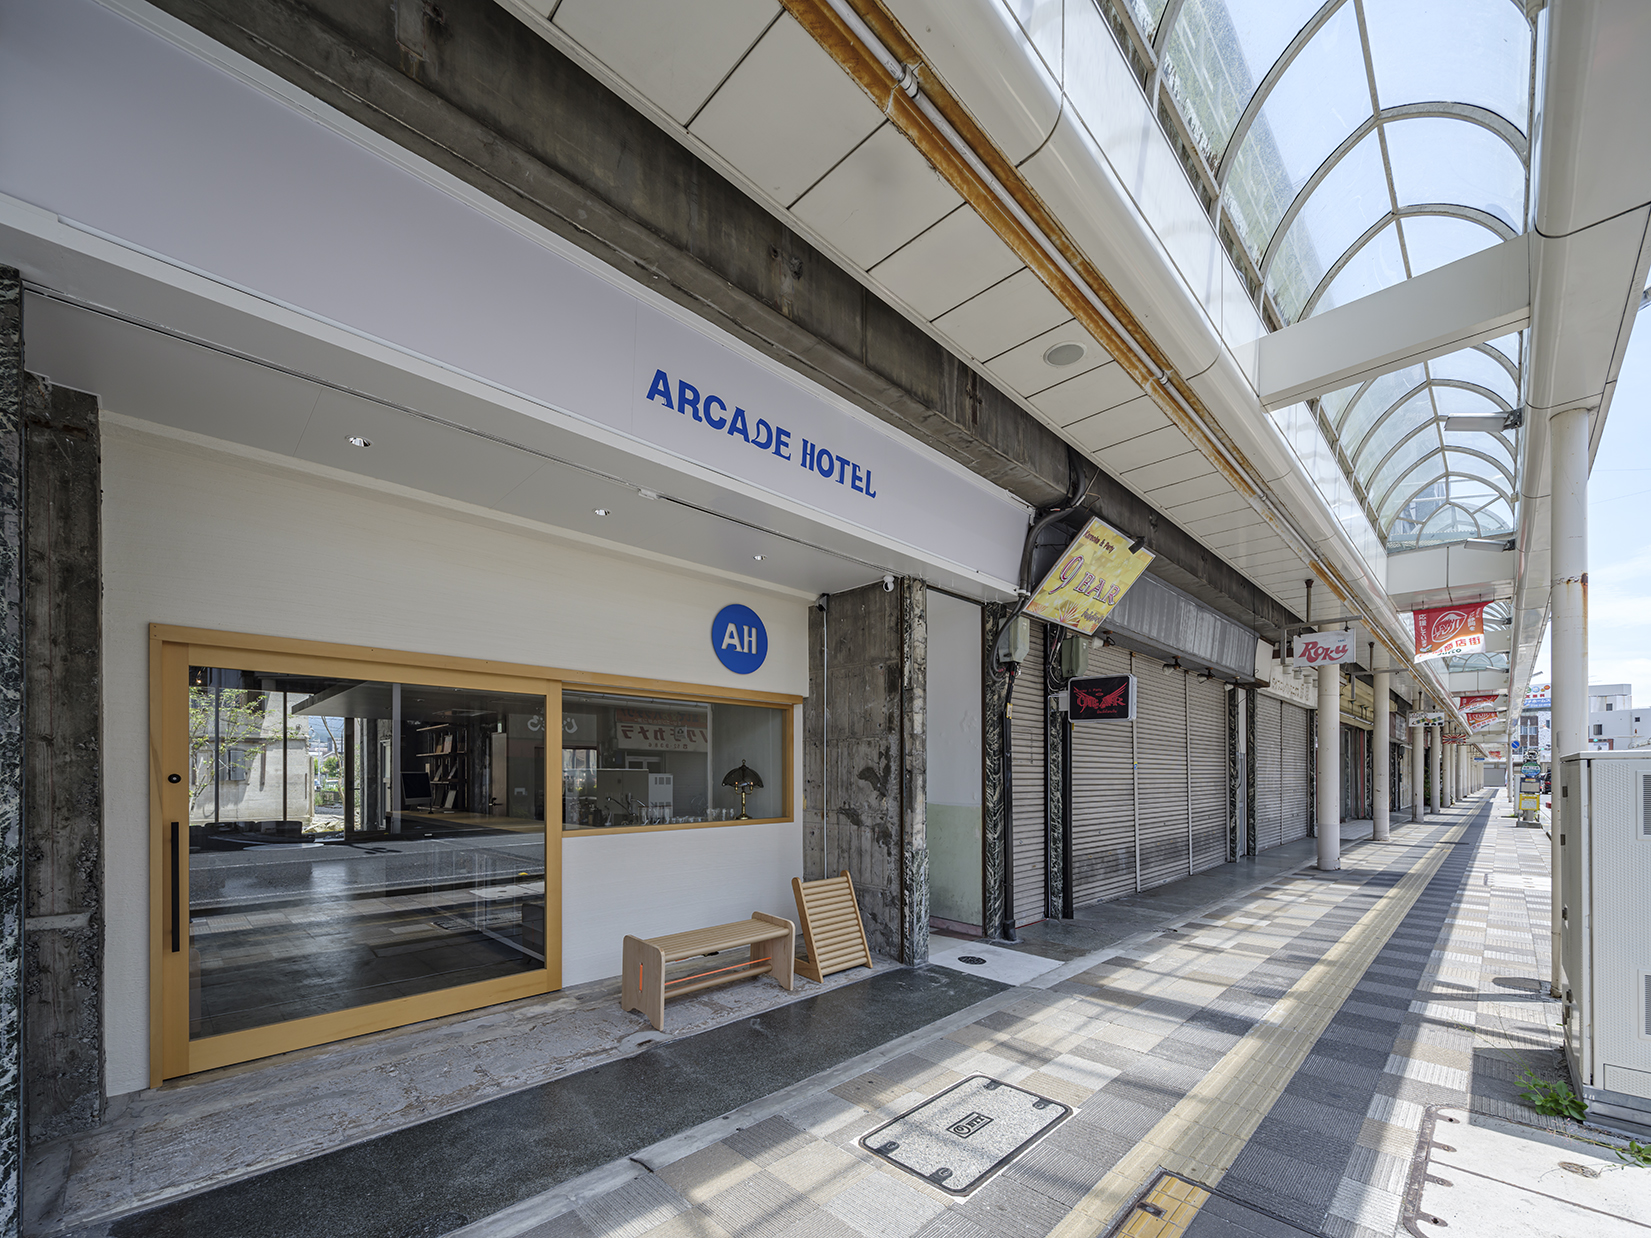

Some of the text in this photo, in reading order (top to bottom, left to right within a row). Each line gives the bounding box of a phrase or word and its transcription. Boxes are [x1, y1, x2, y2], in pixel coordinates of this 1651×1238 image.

[646, 368, 877, 499] ARCADE HOTEL
[1048, 554, 1121, 605] 9 BAR
[721, 622, 758, 655] AH
[1298, 641, 1349, 663] Roku
[965, 1115, 985, 1128] NTT
